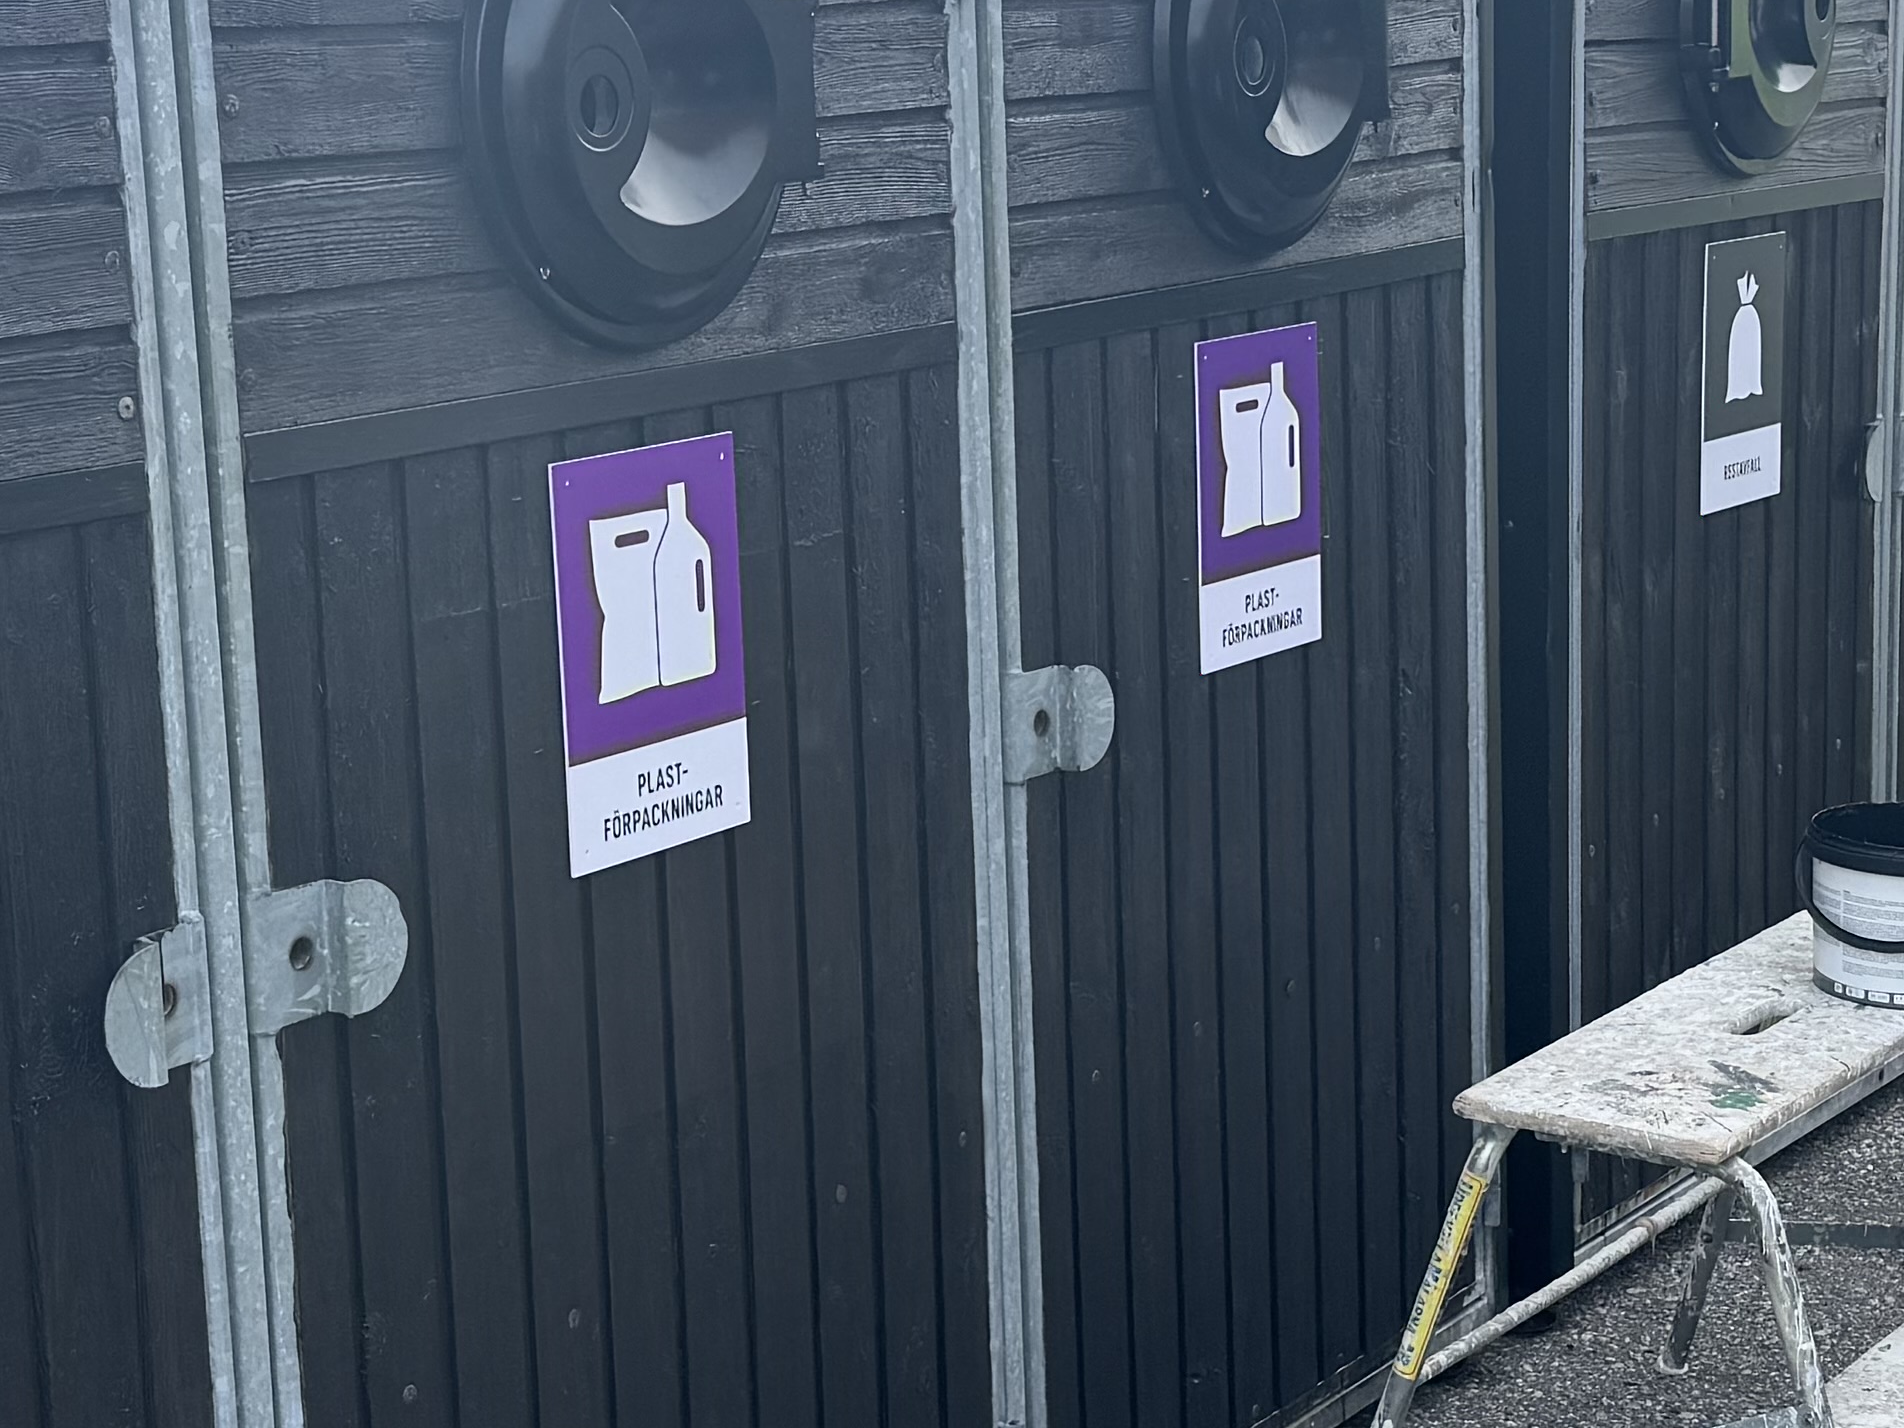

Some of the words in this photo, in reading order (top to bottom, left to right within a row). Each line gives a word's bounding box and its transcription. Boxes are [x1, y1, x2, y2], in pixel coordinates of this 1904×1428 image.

[1245, 587, 1279, 613] PLAST-
[637, 762, 689, 797] PLAST-
[603, 784, 723, 842] FÖRPACKNINGAR
